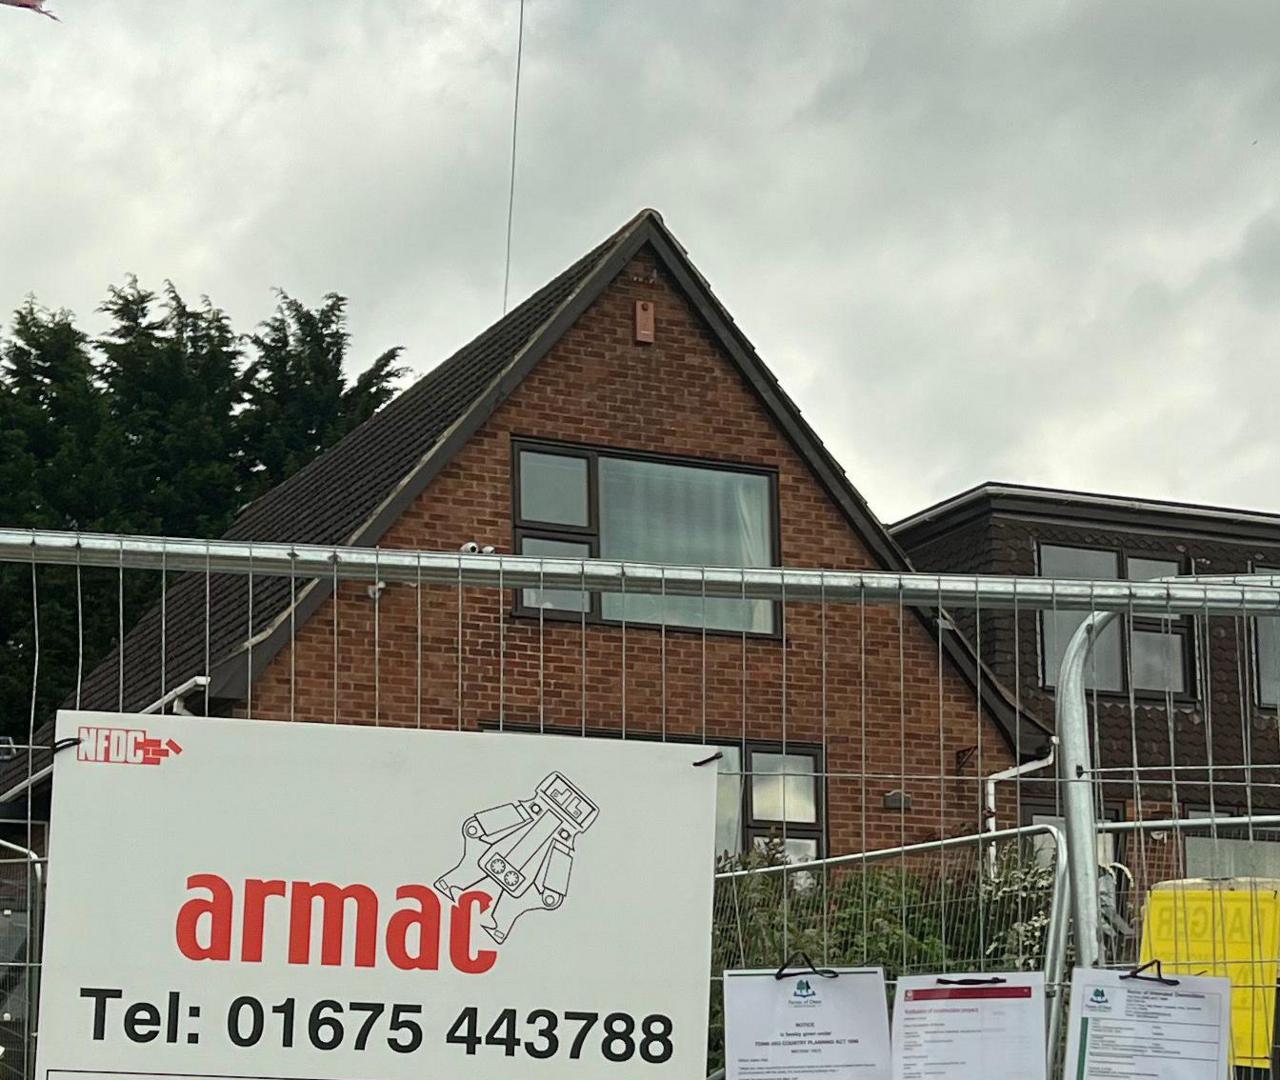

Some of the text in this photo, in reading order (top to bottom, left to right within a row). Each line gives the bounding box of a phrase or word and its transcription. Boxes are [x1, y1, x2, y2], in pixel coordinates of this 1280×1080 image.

[78, 726, 145, 764] NFDC
[175, 873, 498, 974] armac
[80, 987, 674, 1064] Tel: 01675 443788
